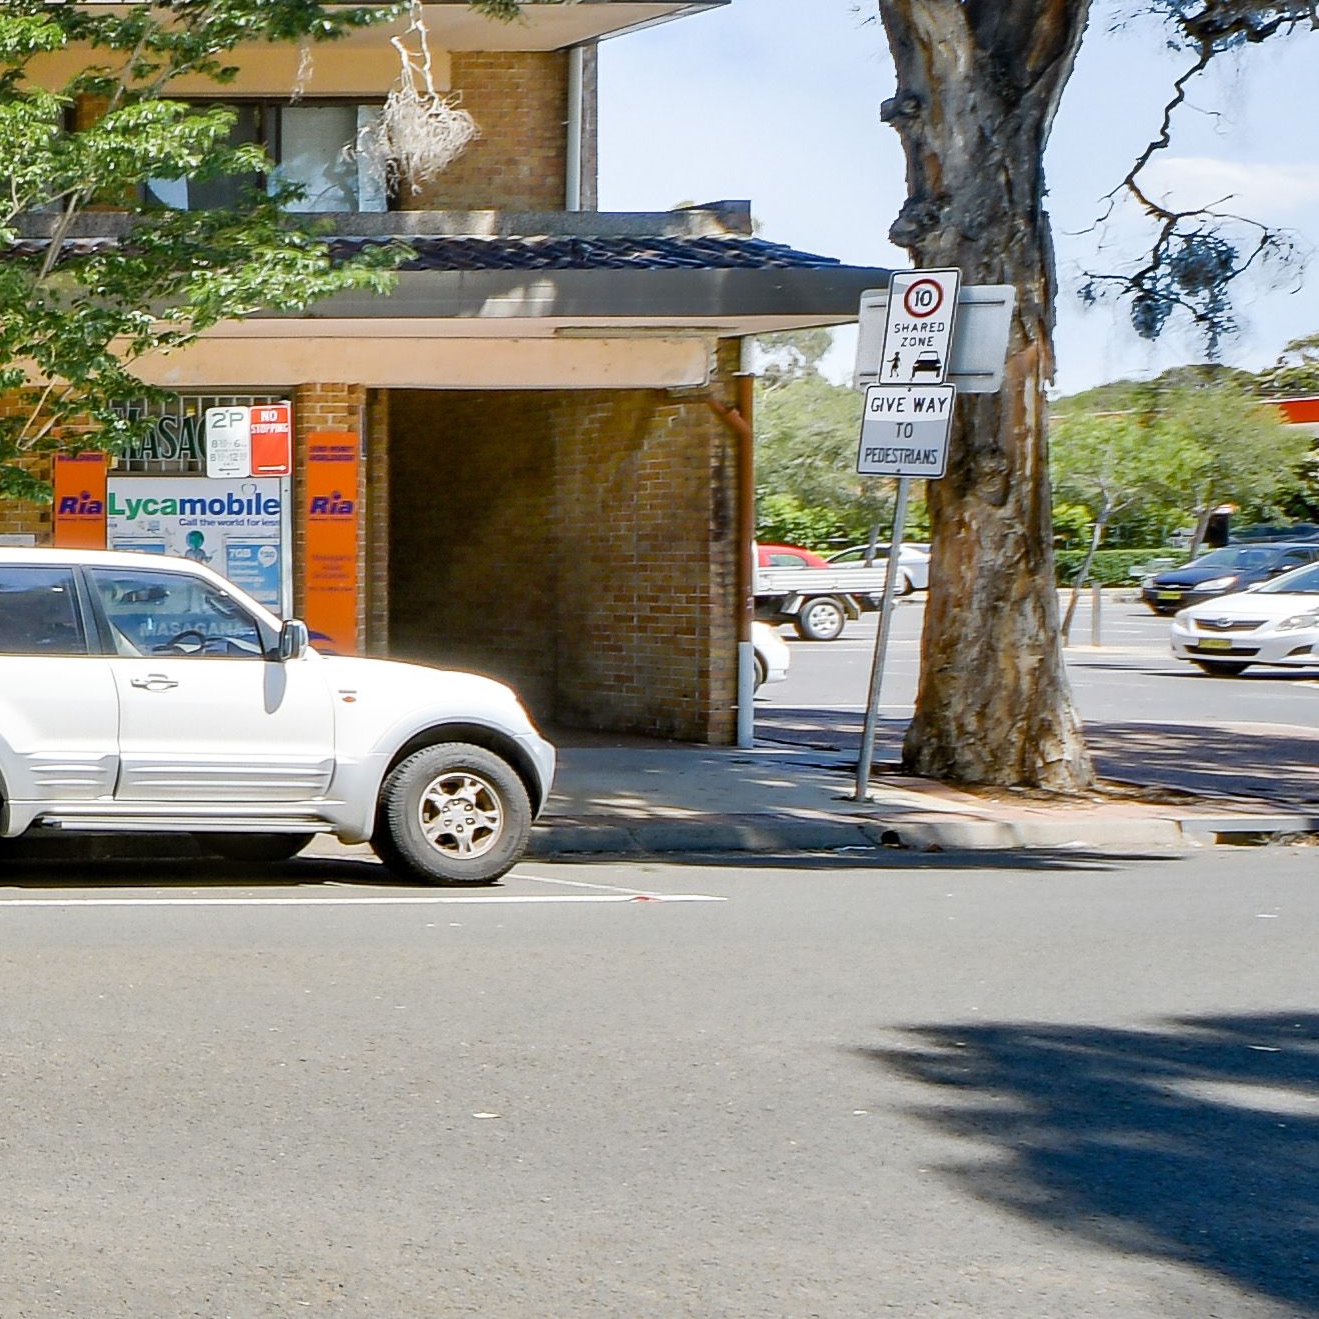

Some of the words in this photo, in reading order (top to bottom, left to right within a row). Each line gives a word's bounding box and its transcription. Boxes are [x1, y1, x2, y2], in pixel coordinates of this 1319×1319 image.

[914, 290, 933, 307] 10
[894, 322, 945, 333] SHARED
[901, 336, 934, 347] ZONE
[870, 397, 906, 413] GIVE
[913, 397, 949, 413] WAY
[211, 412, 244, 428] 2P
[260, 410, 278, 422] NO
[251, 423, 289, 434] STOPPING
[896, 422, 913, 439] TO
[864, 447, 938, 465] PEDESTRIANS
[58, 490, 103, 515] Ria
[109, 492, 281, 521] Lycamobile
[309, 490, 354, 515] Ria
[179, 518, 198, 526] Call
[199, 518, 216, 526] the
[217, 518, 245, 526] world
[247, 518, 259, 526] for
